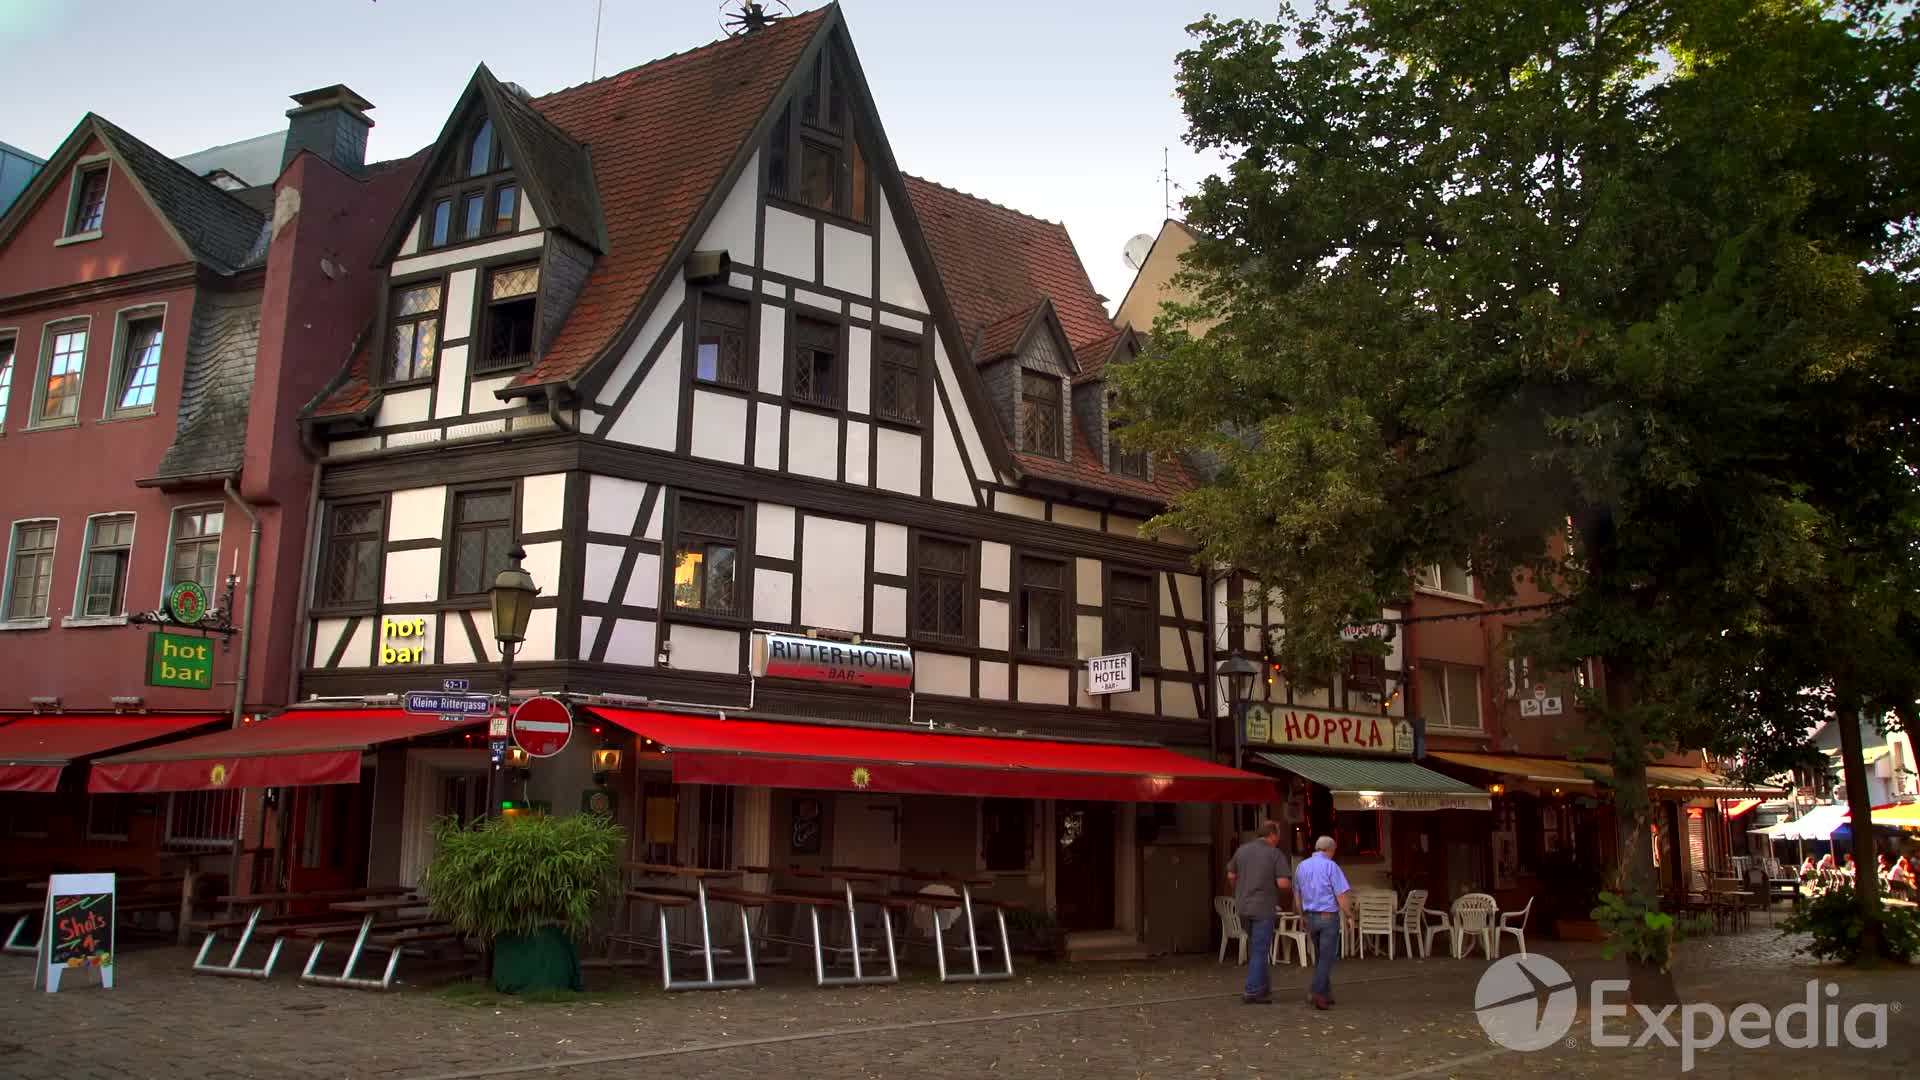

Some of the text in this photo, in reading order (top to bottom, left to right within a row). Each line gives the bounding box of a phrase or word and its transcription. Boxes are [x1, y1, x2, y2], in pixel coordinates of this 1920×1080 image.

[383, 617, 425, 638] hot
[163, 639, 206, 661] hot
[382, 640, 424, 664] bar
[772, 640, 911, 672] RITTER HOTEL
[161, 660, 205, 681] bar
[1093, 657, 1127, 671] RITTER
[1095, 670, 1127, 683] HOTEL
[412, 696, 487, 711] Kleine Rittergasse
[1284, 711, 1384, 748] HOPPLA
[58, 911, 106, 939] Shots
